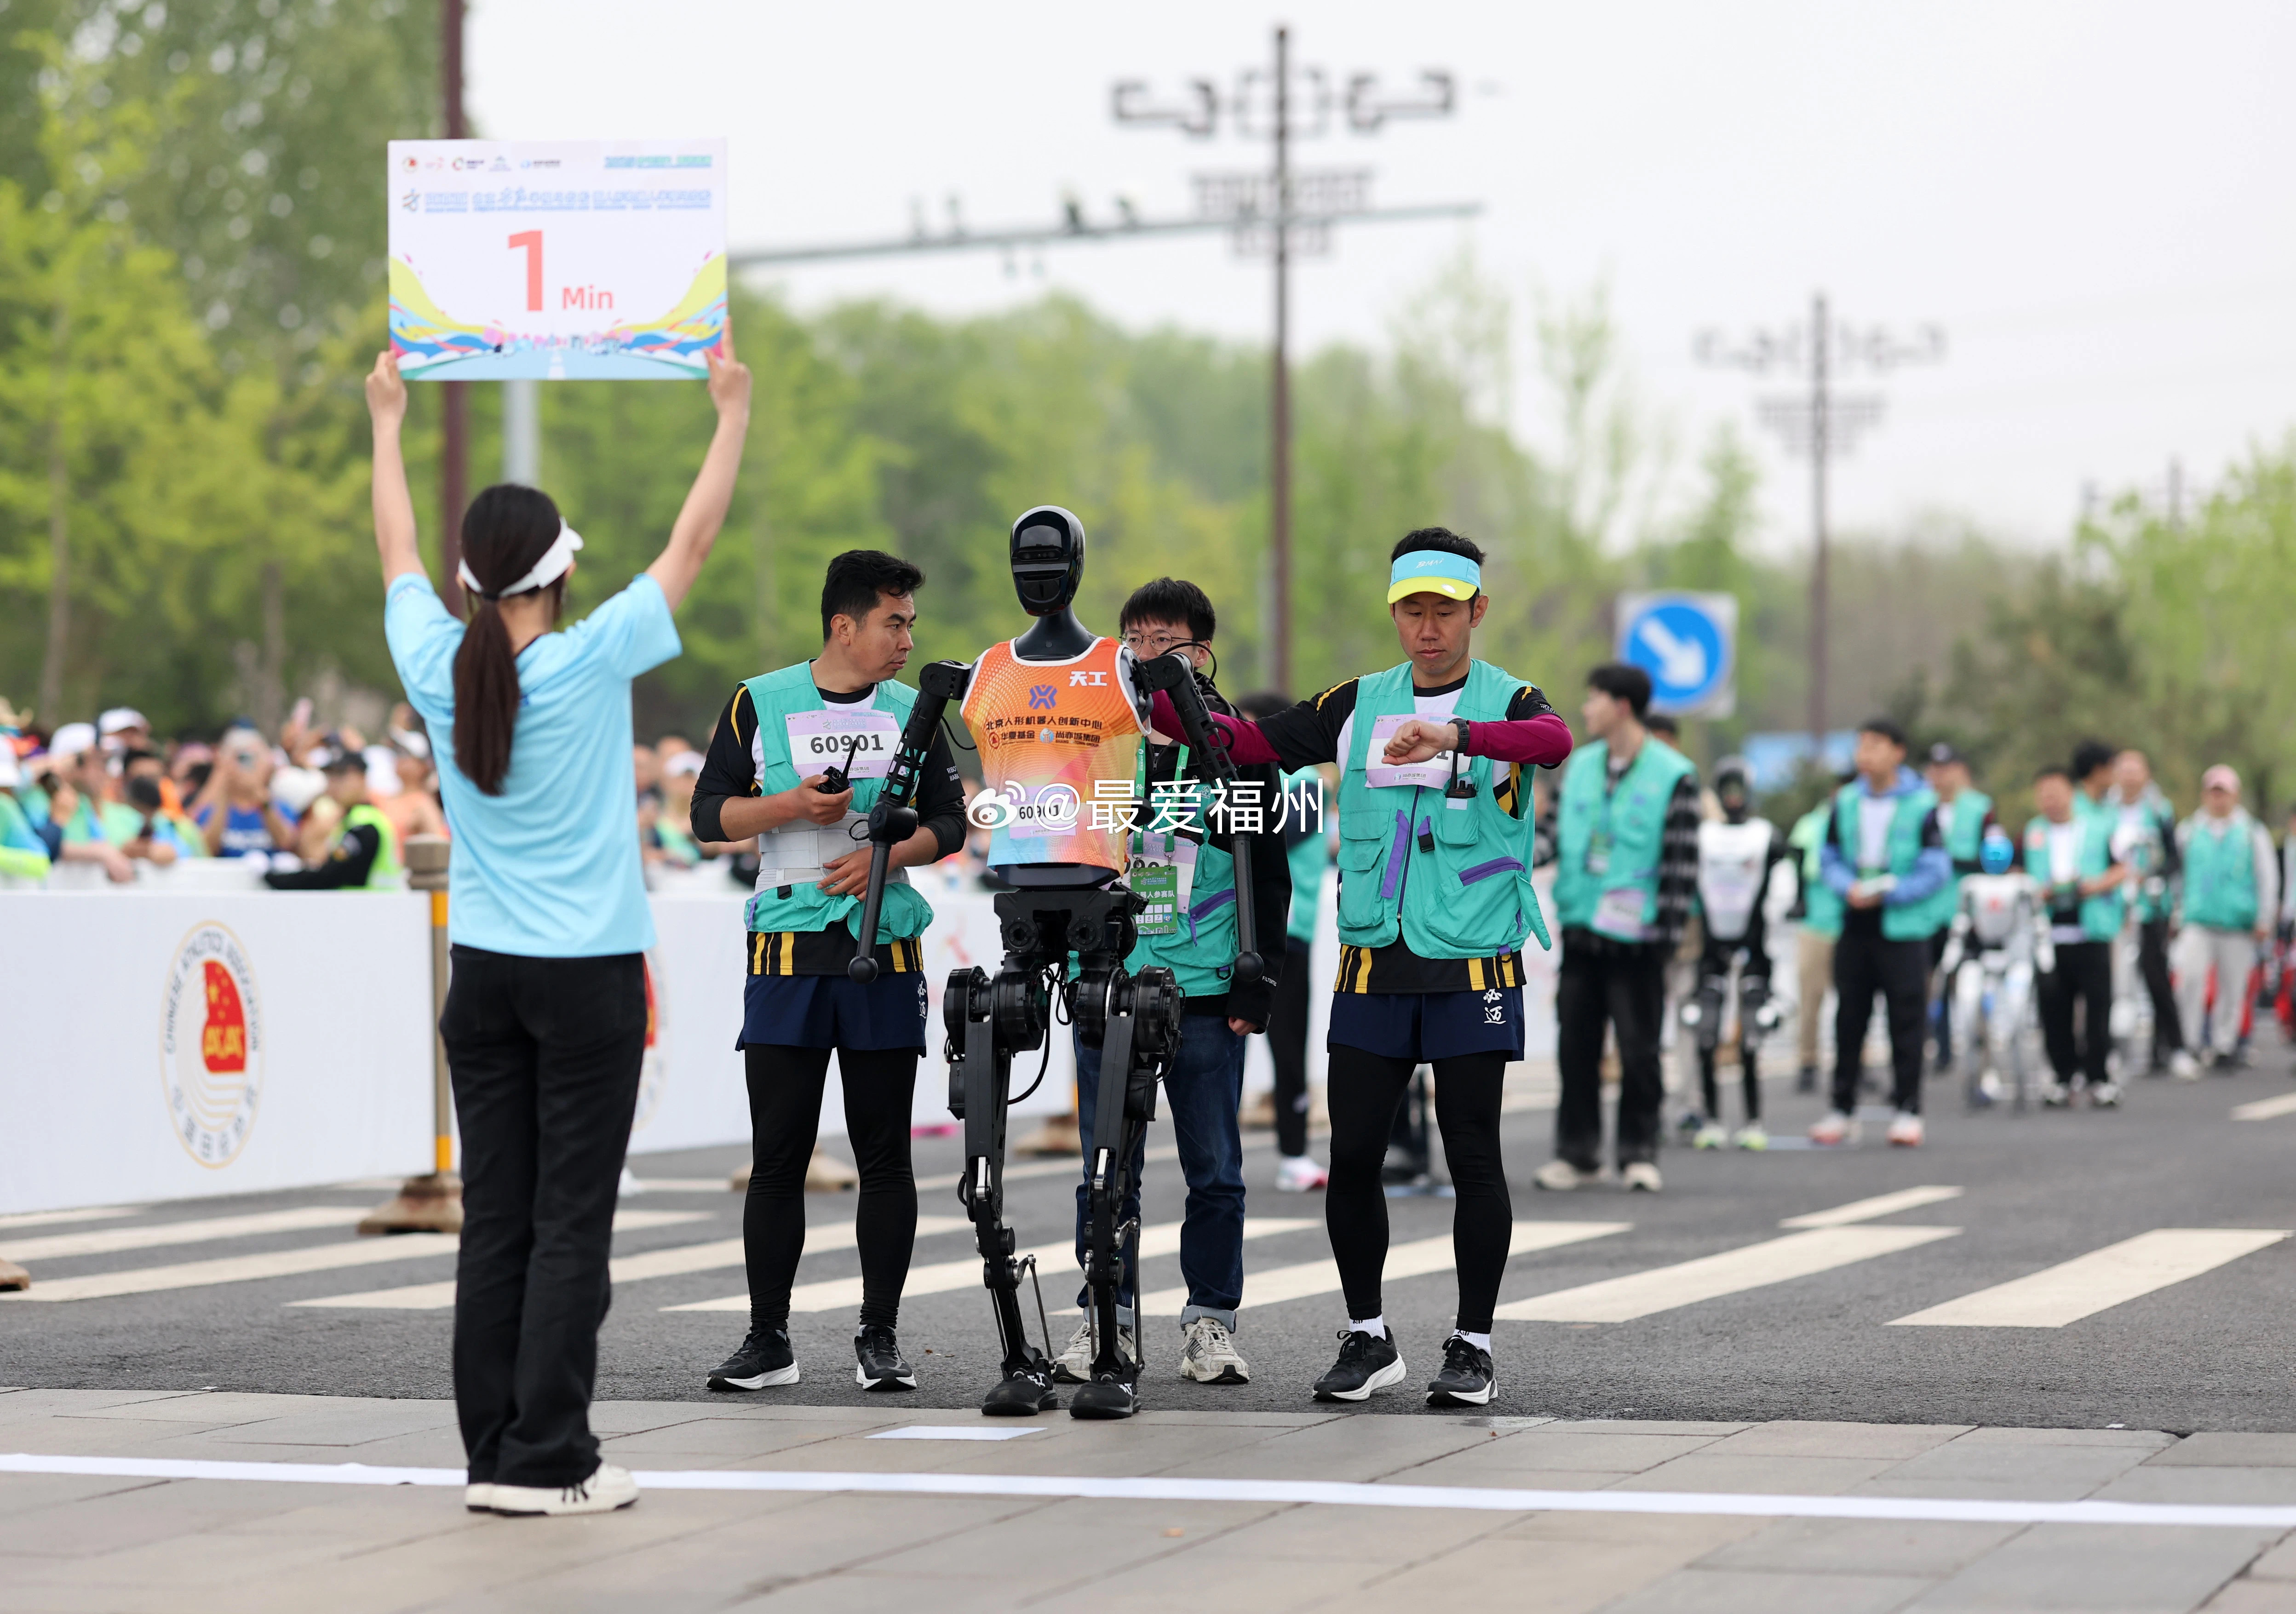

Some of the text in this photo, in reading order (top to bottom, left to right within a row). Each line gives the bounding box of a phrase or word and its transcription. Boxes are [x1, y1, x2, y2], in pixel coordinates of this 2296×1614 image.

[508, 230, 613, 312] 1 Min
[1069, 671, 1107, 687] 天工
[986, 716, 1102, 730] 北京人形机器人创新中心
[1001, 730, 1035, 740] 华夏基金
[810, 734, 884, 753] 60901
[1136, 890, 1175, 898] 器人参赛队
